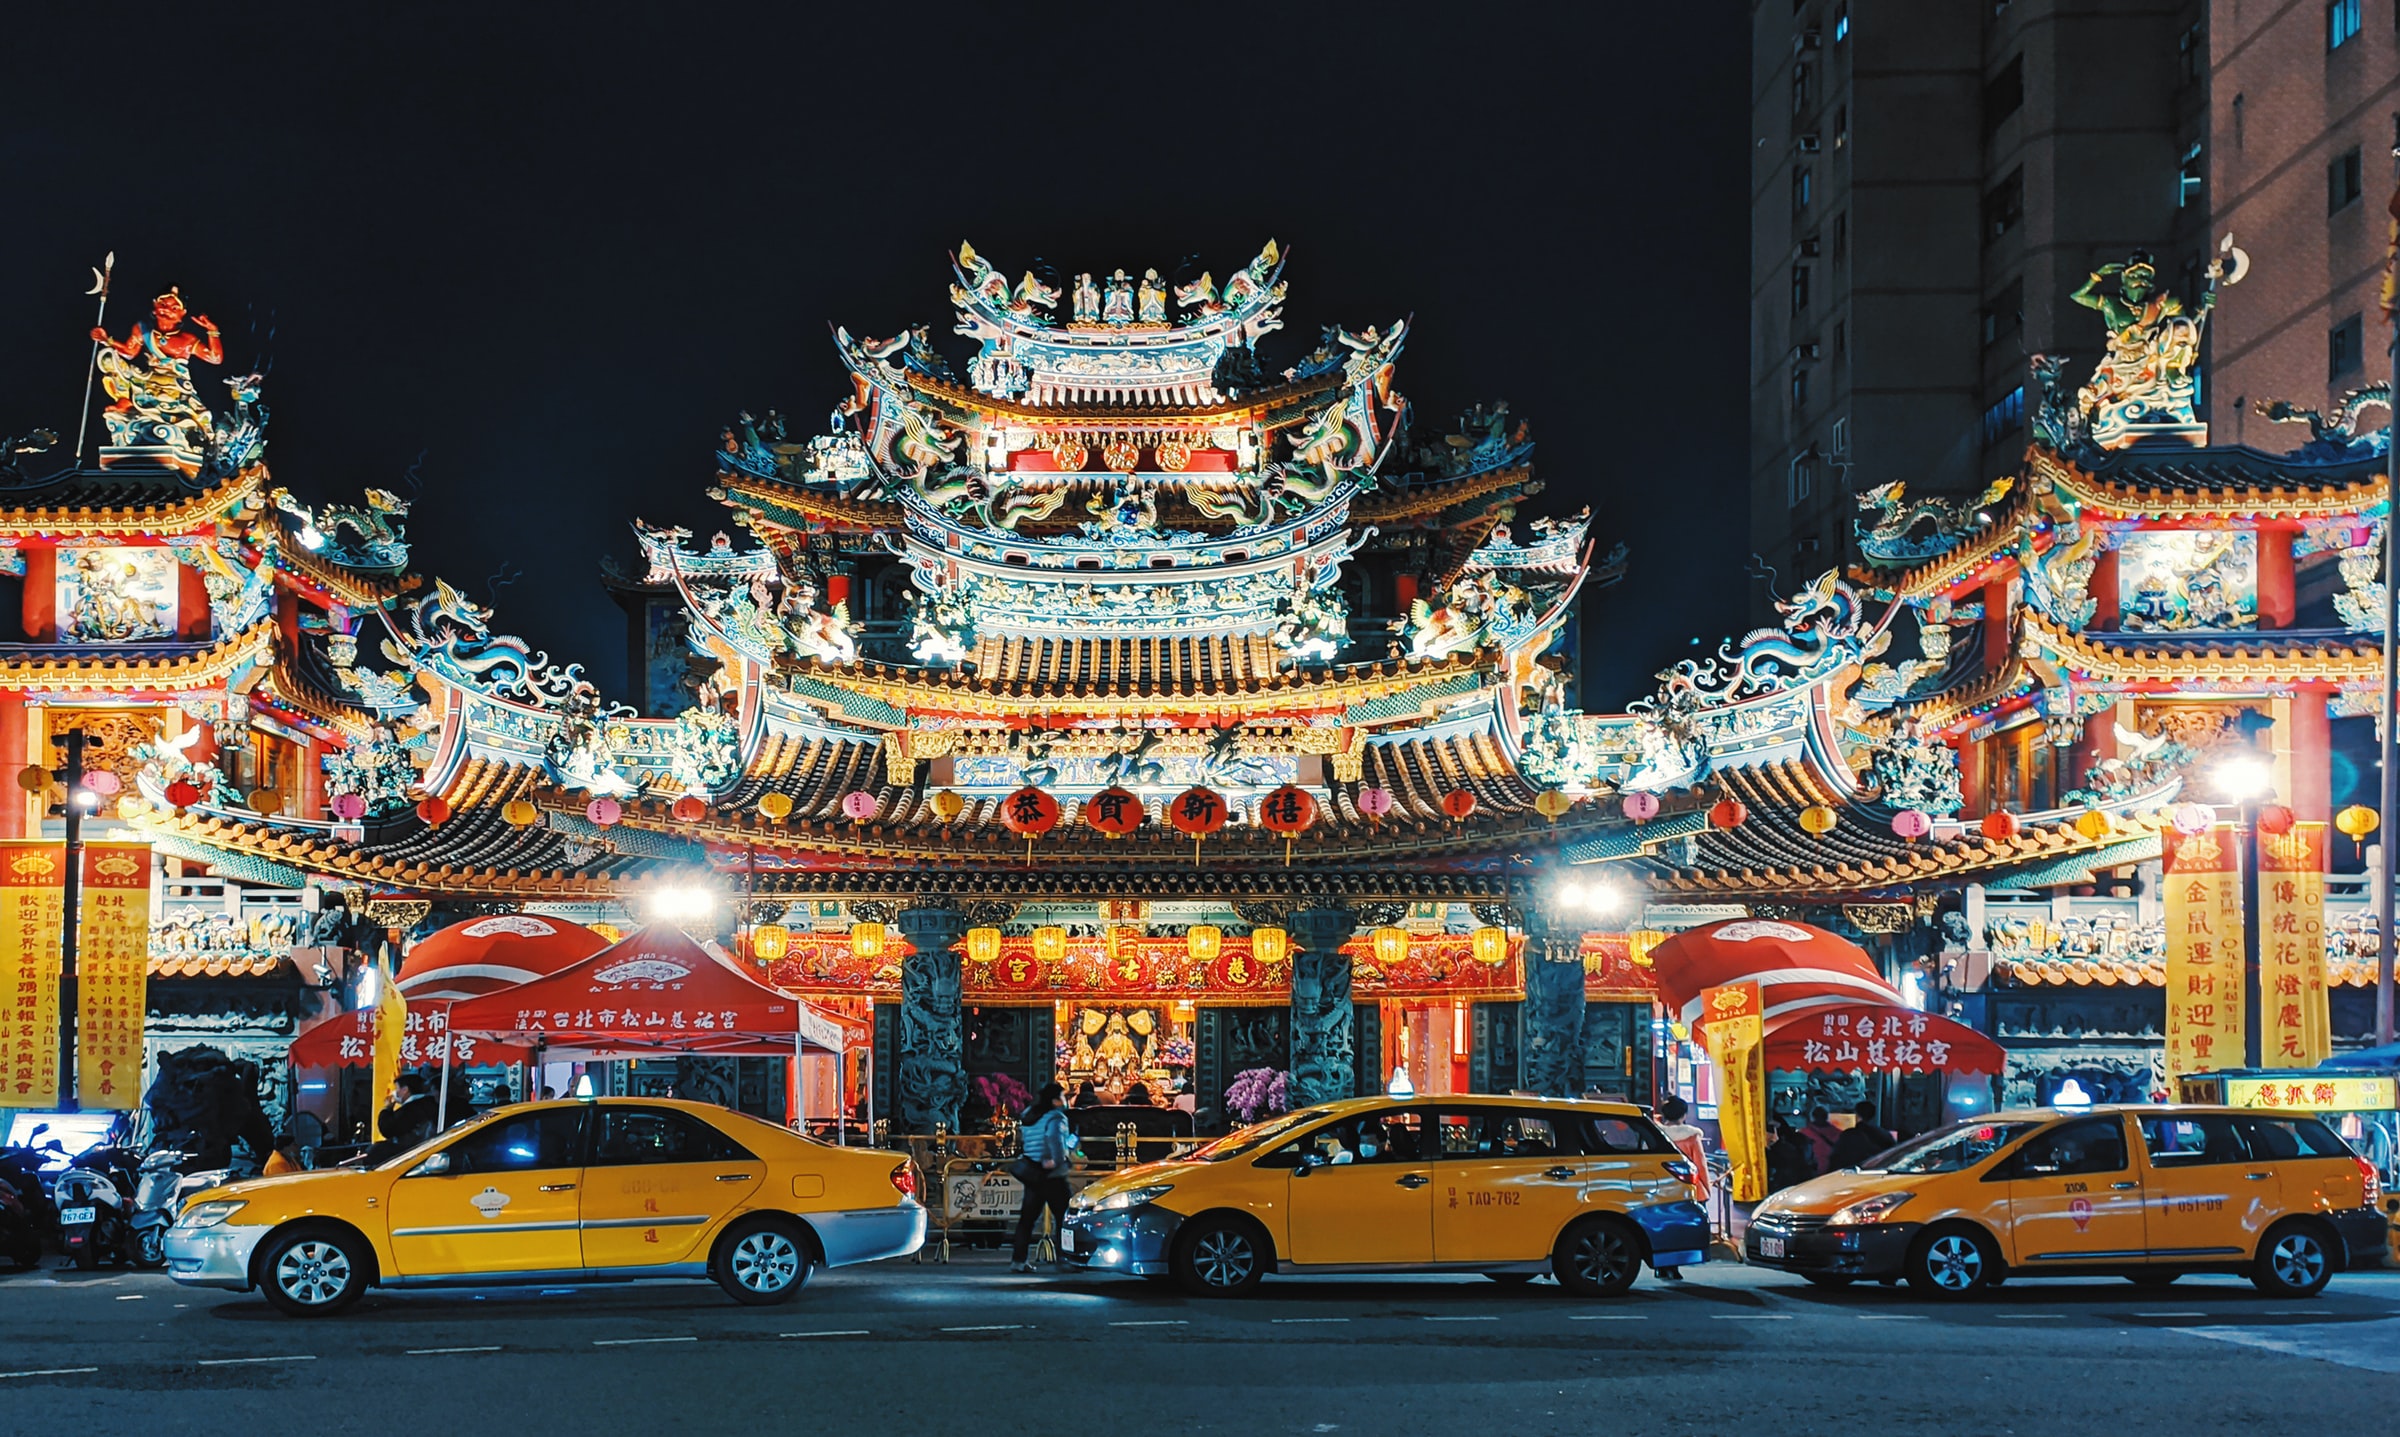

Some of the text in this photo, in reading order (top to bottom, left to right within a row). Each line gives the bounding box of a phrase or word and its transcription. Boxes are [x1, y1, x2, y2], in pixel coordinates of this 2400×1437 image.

[2272, 880, 2305, 1067] 傳統花燈慶元
[1856, 1014, 1930, 1039] 台北市
[1803, 1038, 1952, 1067] 松山慈祐宮
[1467, 1191, 1520, 1207] TAQ-762
